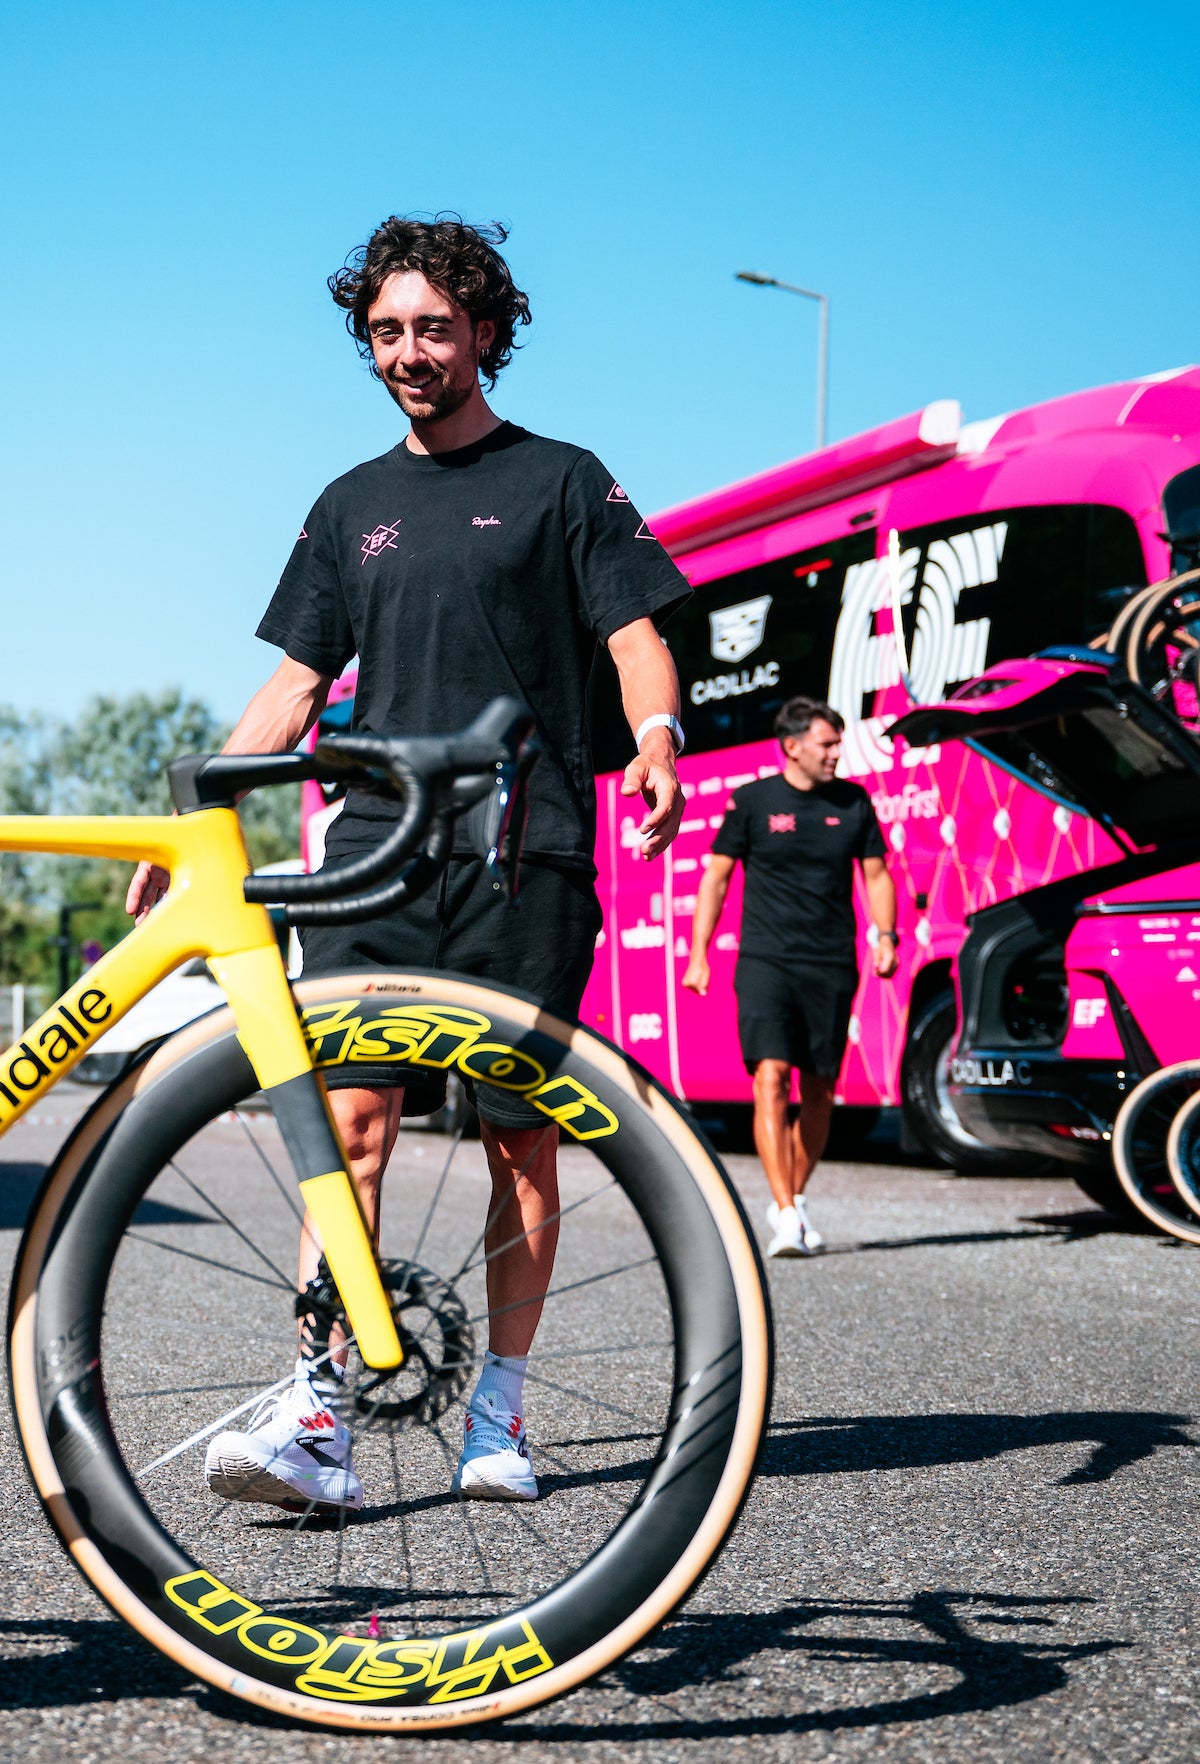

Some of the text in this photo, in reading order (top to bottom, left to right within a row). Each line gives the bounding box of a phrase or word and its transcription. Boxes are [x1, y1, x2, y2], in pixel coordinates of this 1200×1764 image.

[370, 530, 389, 550] EF
[690, 662, 780, 705] CADILLAC
[1073, 998, 1107, 1025] EF
[164, 1569, 555, 1704] Vision
